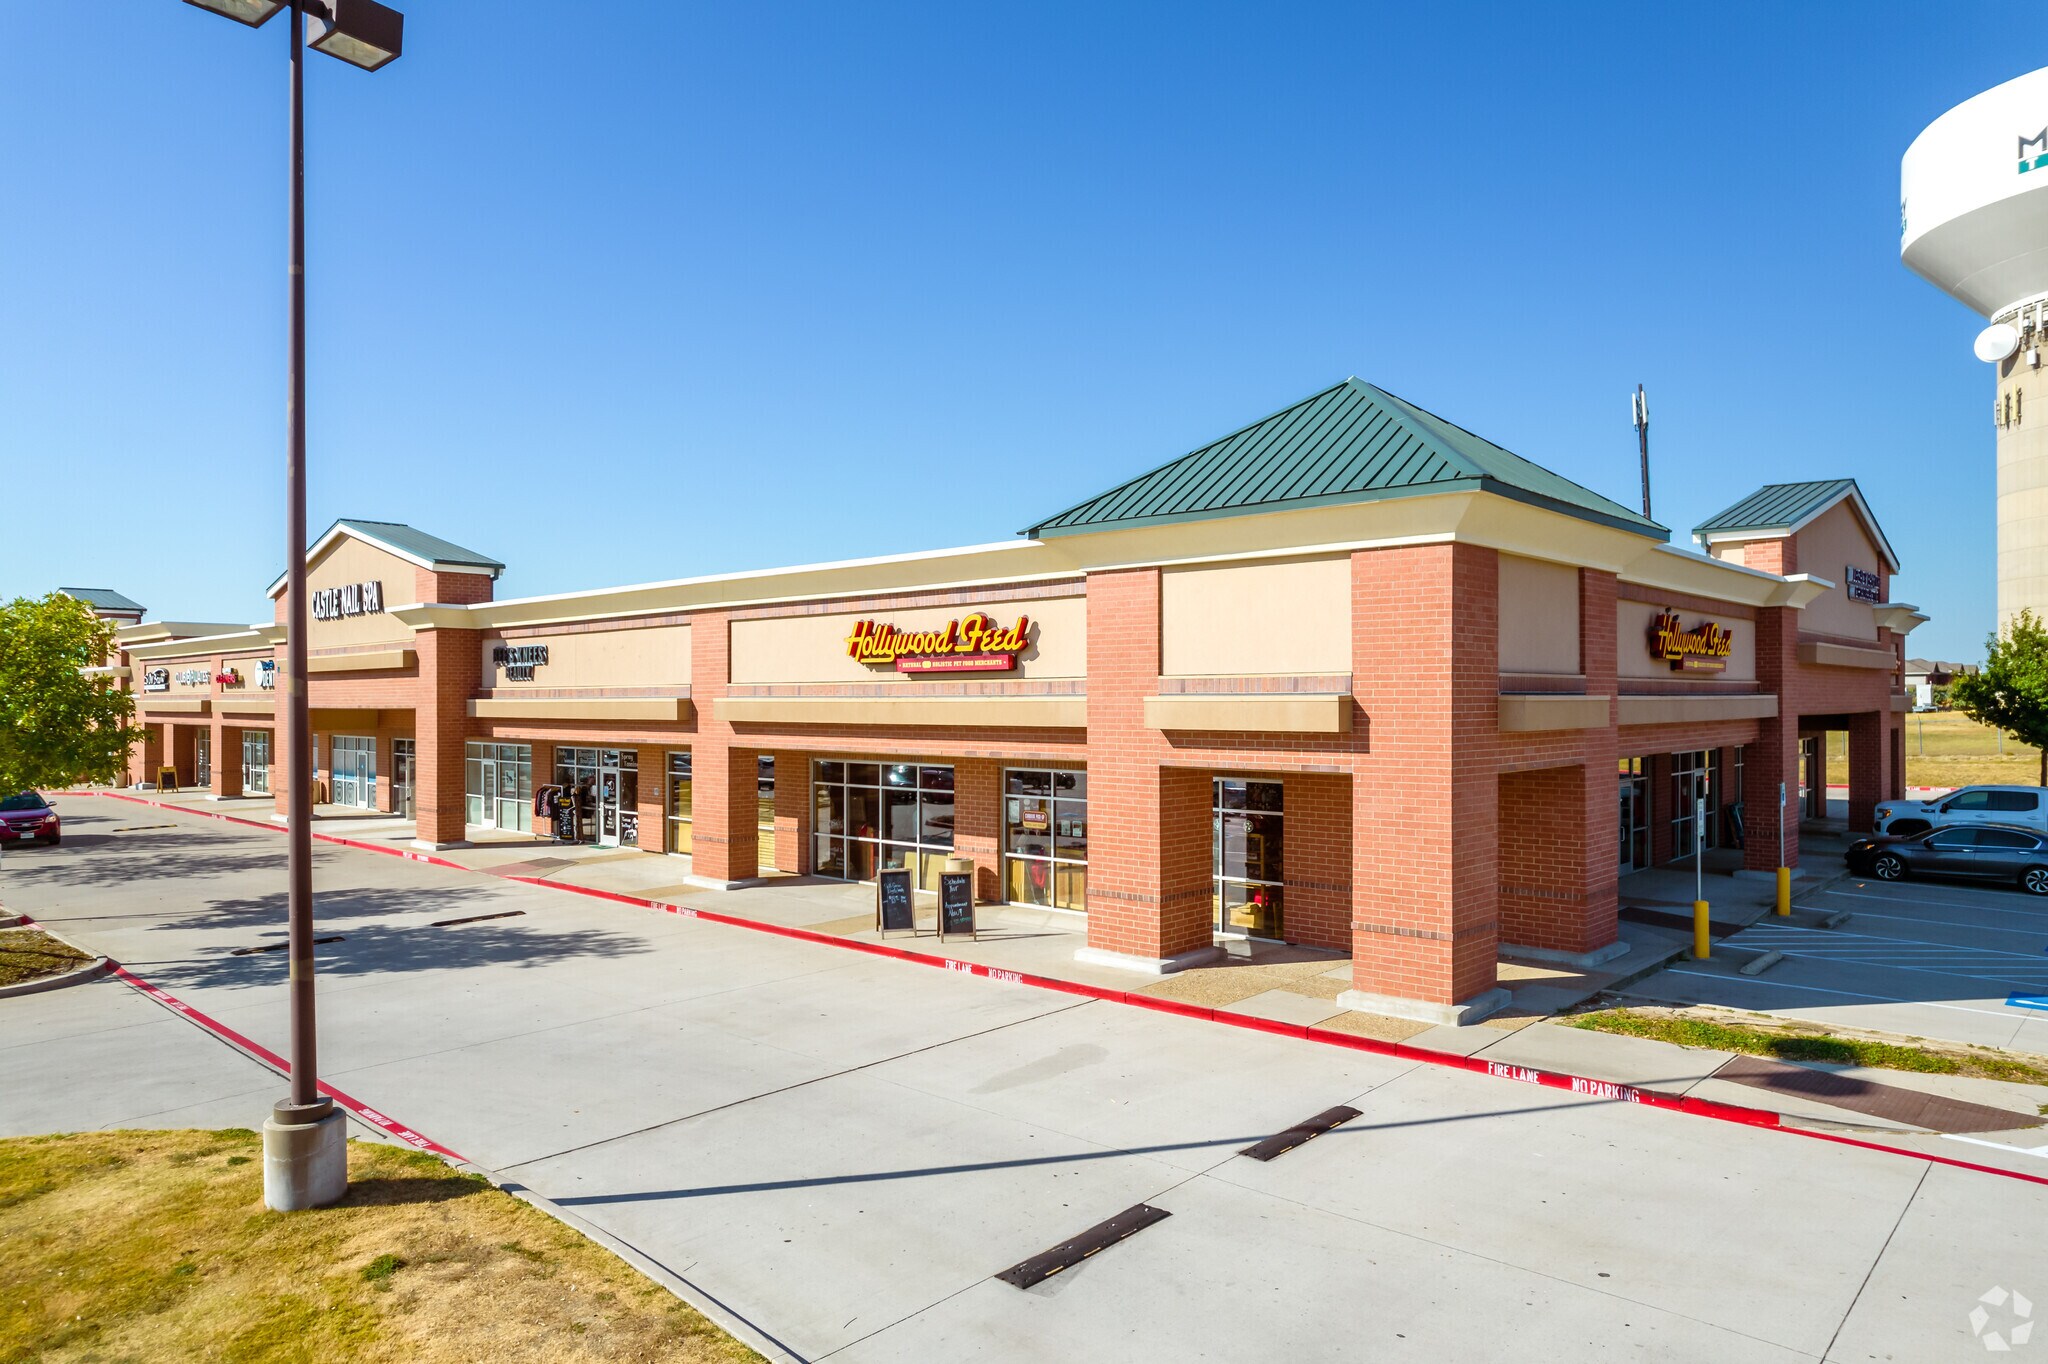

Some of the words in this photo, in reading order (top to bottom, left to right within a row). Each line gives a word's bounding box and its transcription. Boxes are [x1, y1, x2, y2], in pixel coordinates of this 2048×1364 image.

[312, 588, 340, 618] CASTLE
[341, 583, 360, 614] NAIL
[363, 580, 379, 612] SPA
[844, 620, 953, 663] Hollywood
[955, 613, 1025, 652] Feed
[1659, 614, 1709, 659] Hollywood
[1708, 623, 1732, 656] Feed
[945, 959, 957, 970] FIRE
[957, 962, 972, 974] LANE
[988, 967, 996, 979] NO
[997, 970, 1023, 984] PARKING
[1488, 1061, 1510, 1078] FIRE
[1512, 1066, 1540, 1084] LANE
[1572, 1077, 1588, 1093] NO
[1590, 1082, 1640, 1103] PARKING
